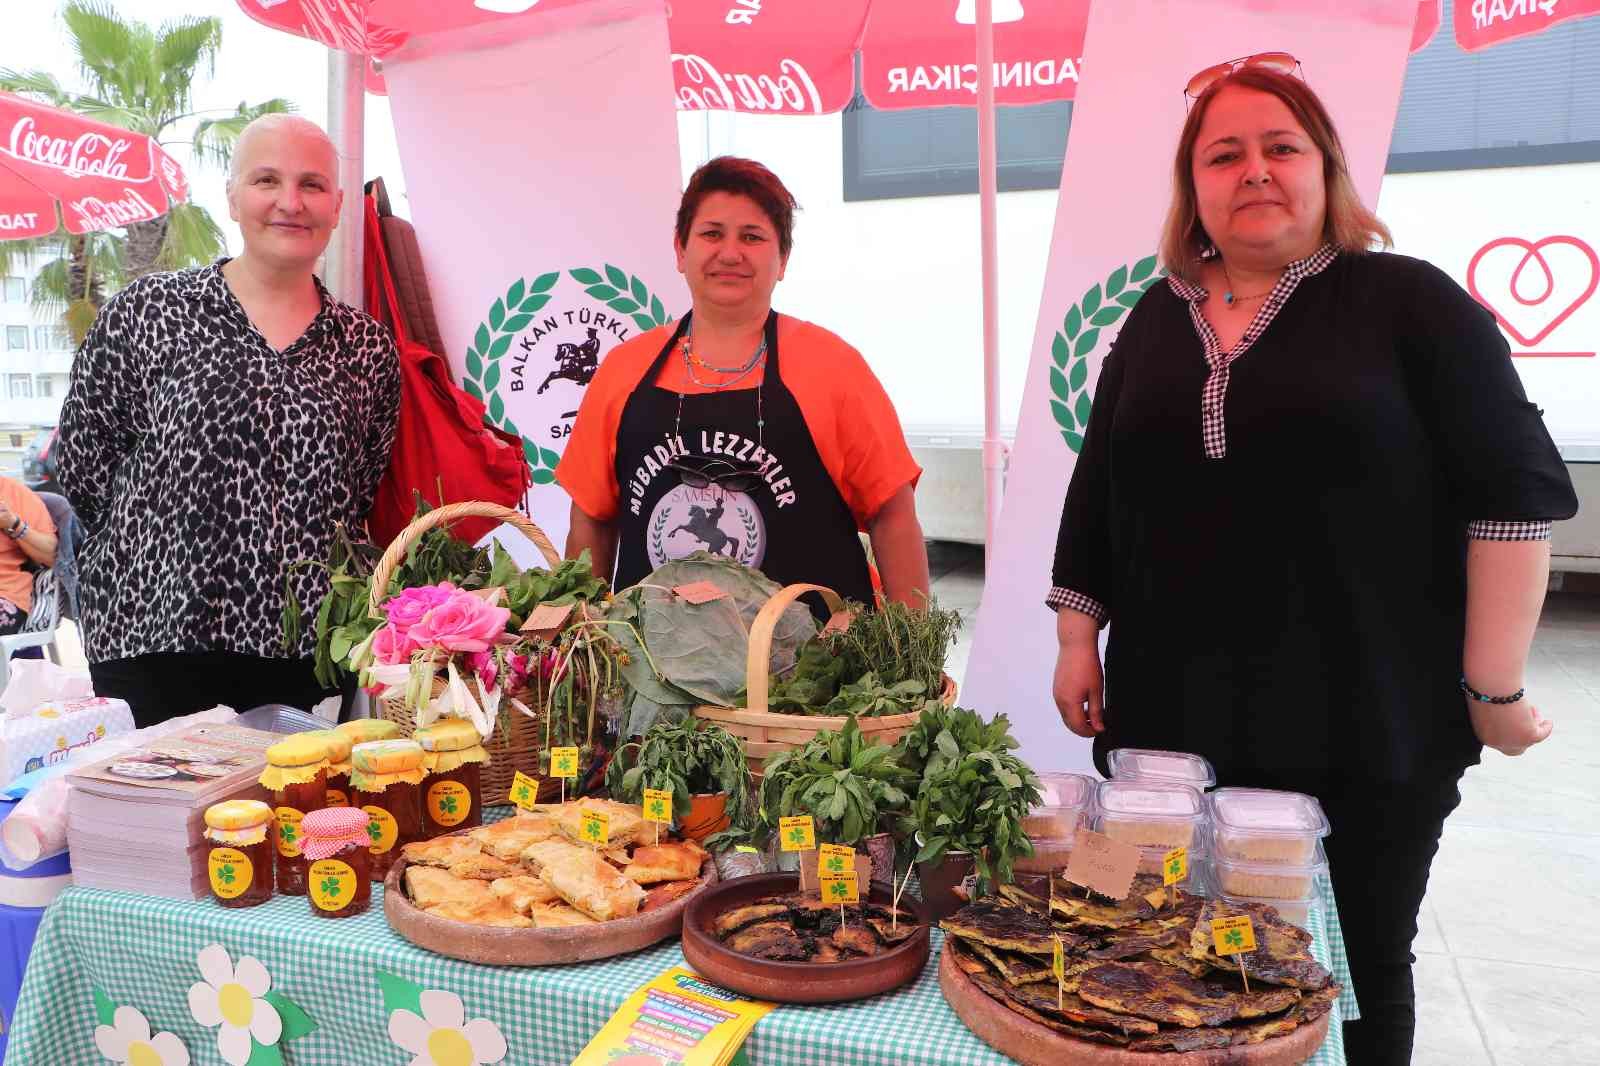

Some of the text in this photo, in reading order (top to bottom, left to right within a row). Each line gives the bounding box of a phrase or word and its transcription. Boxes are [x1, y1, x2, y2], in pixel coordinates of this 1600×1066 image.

[510, 307, 629, 392] BALKAN TÜRKL
[550, 423, 573, 439] SA
[630, 430, 796, 516] MÜBADİL LEZZETLER
